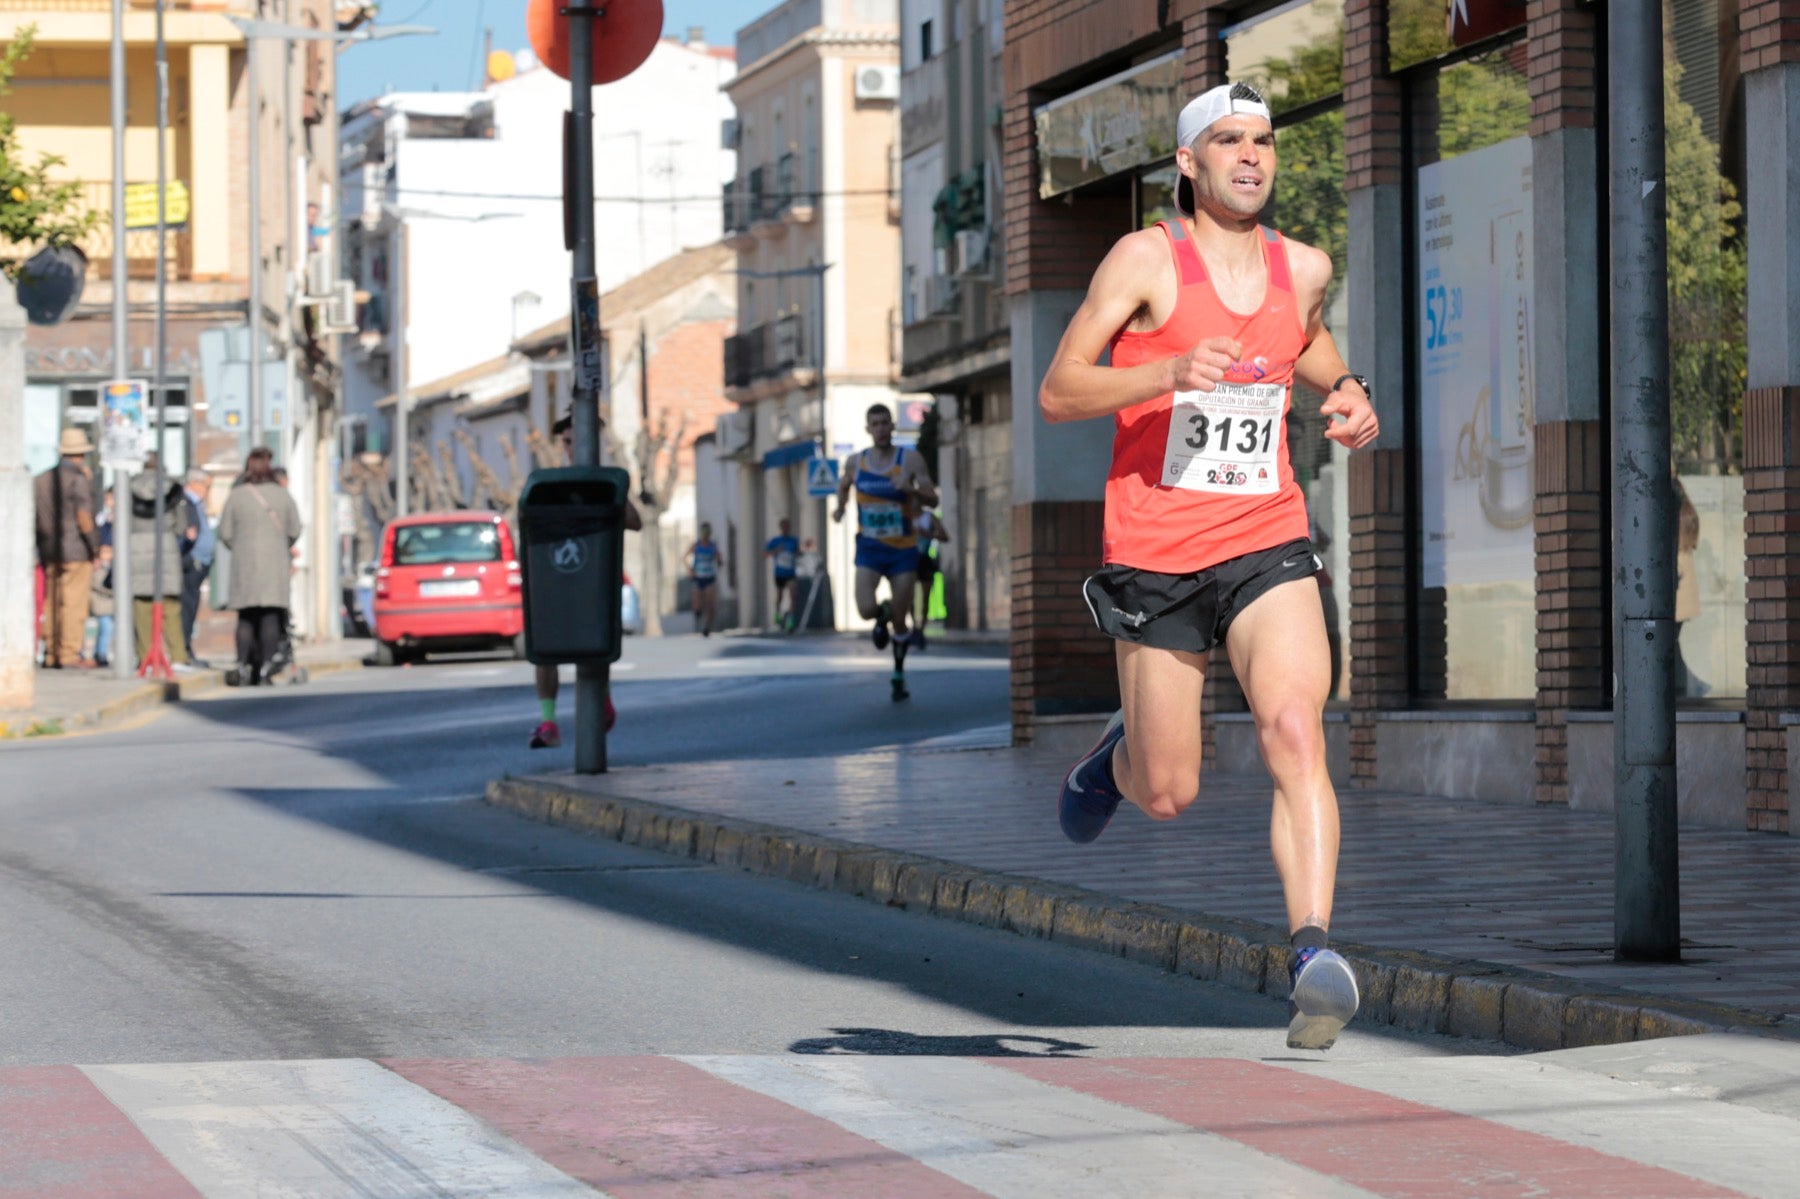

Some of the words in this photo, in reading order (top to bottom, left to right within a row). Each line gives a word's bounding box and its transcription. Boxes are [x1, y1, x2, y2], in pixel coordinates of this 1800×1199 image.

[1229, 384, 1255, 397] PREMIO
[1257, 387, 1265, 397] DE
[1185, 414, 1272, 454] 3131
